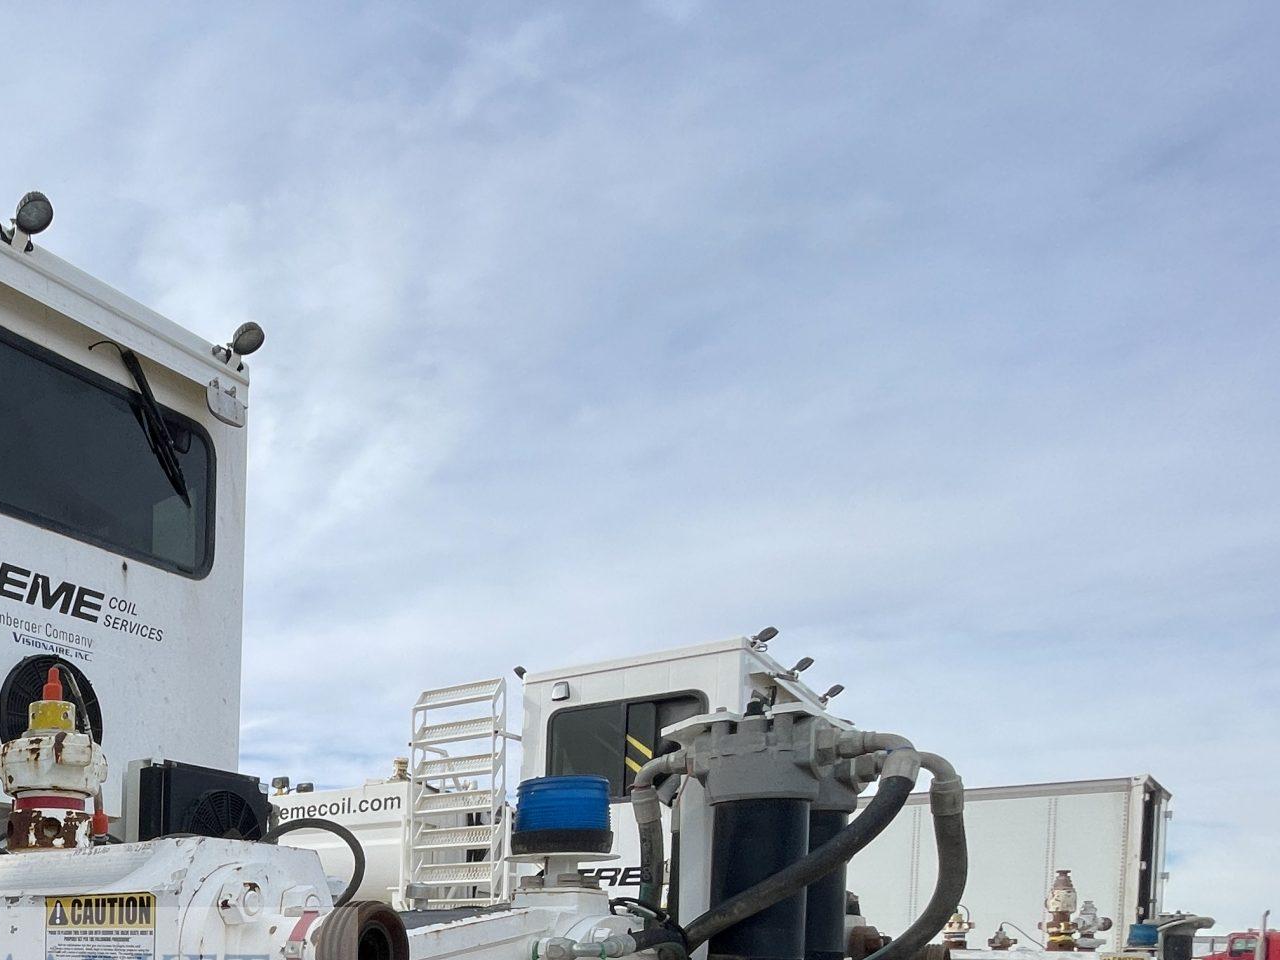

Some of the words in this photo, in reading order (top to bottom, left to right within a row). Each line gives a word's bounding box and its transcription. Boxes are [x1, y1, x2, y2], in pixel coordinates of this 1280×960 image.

[108, 596, 138, 616] COIL
[45, 623, 93, 649] Company
[103, 614, 164, 642] SERVICES
[280, 796, 402, 820] emecoil.com
[71, 896, 151, 925] CAUTION
